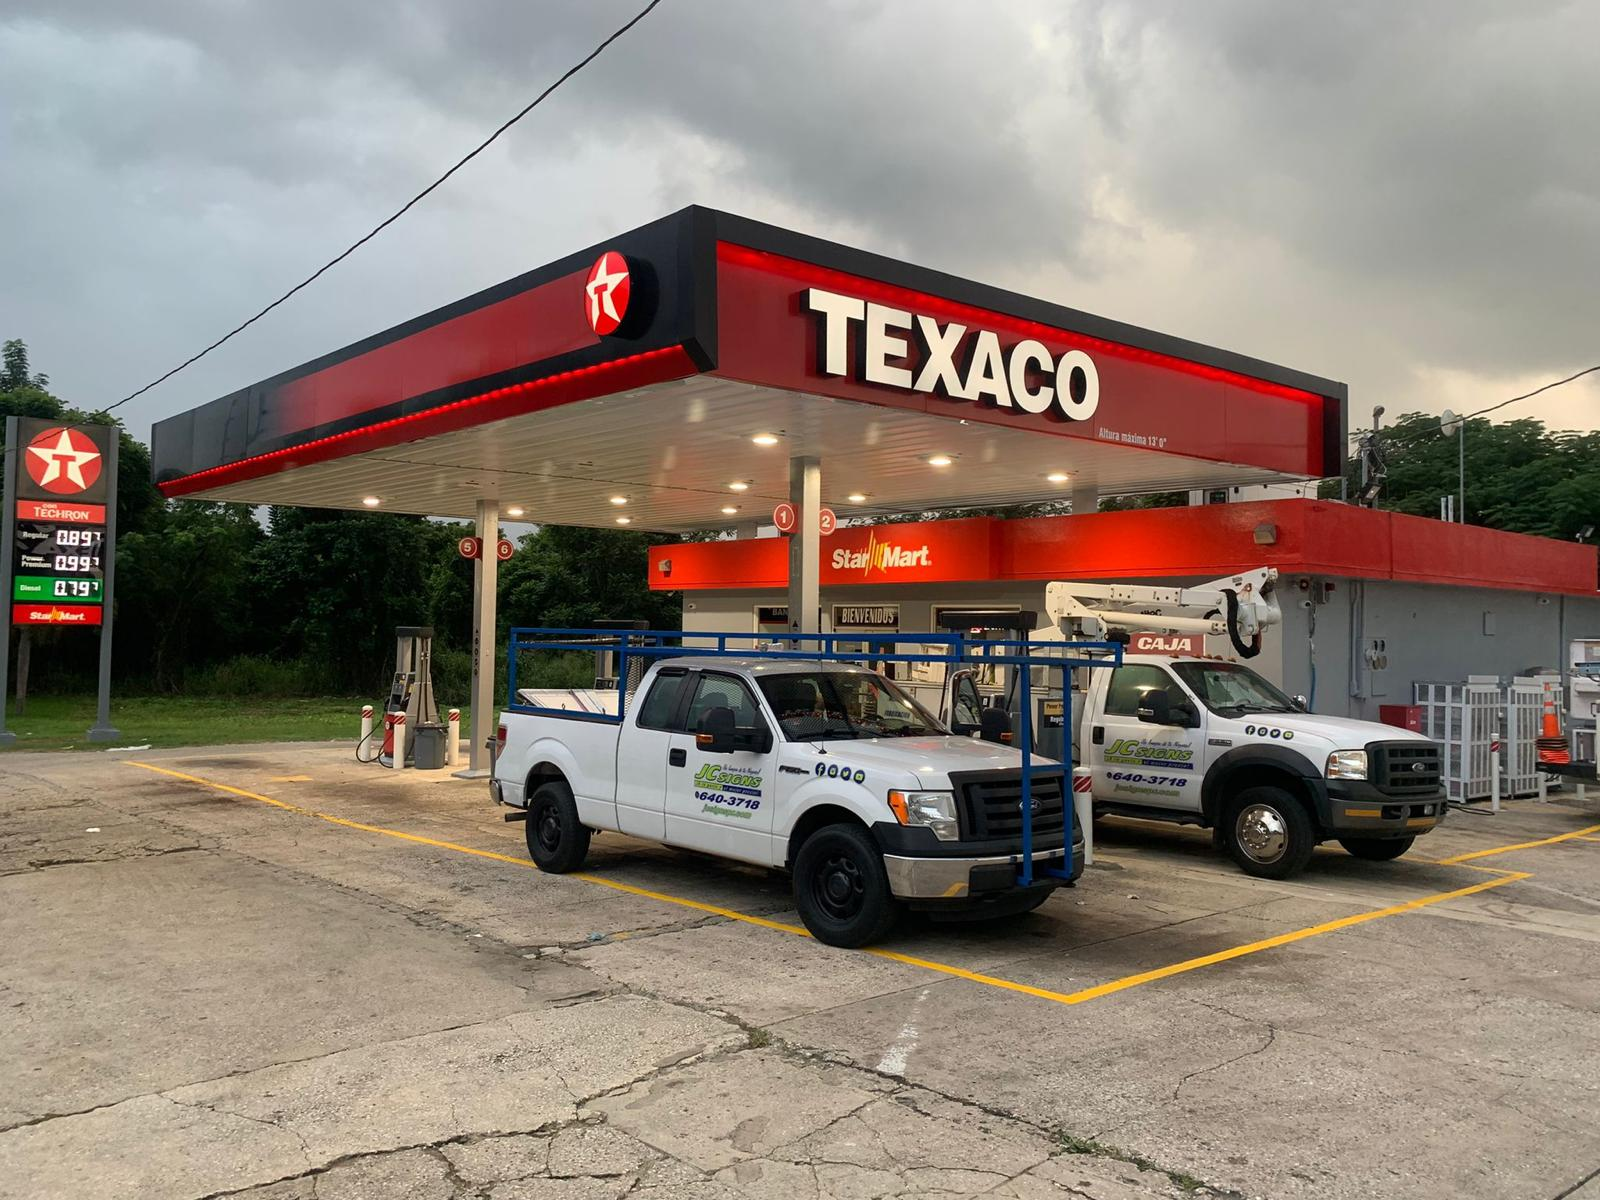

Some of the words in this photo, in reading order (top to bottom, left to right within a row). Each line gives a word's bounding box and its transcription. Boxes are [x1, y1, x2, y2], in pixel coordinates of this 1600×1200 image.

[809, 287, 1099, 421] TEXACO
[1098, 427, 1120, 441] Altura
[33, 506, 90, 521] TECHRON
[780, 510, 787, 524] 1
[821, 515, 831, 528] 2
[22, 531, 50, 540] Regular
[464, 542, 472, 552] 5
[501, 544, 508, 554] 6
[20, 584, 42, 592] Diesel
[841, 607, 895, 624] BIENVENIDOS
[1137, 637, 1191, 651] CAJA
[1104, 739, 1139, 755] JC
[1134, 747, 1193, 761] SIGNS
[694, 763, 722, 781] JC
[716, 772, 763, 788] SIGNS
[1112, 772, 1187, 787] 640-3718
[699, 792, 760, 810] 640-3718
